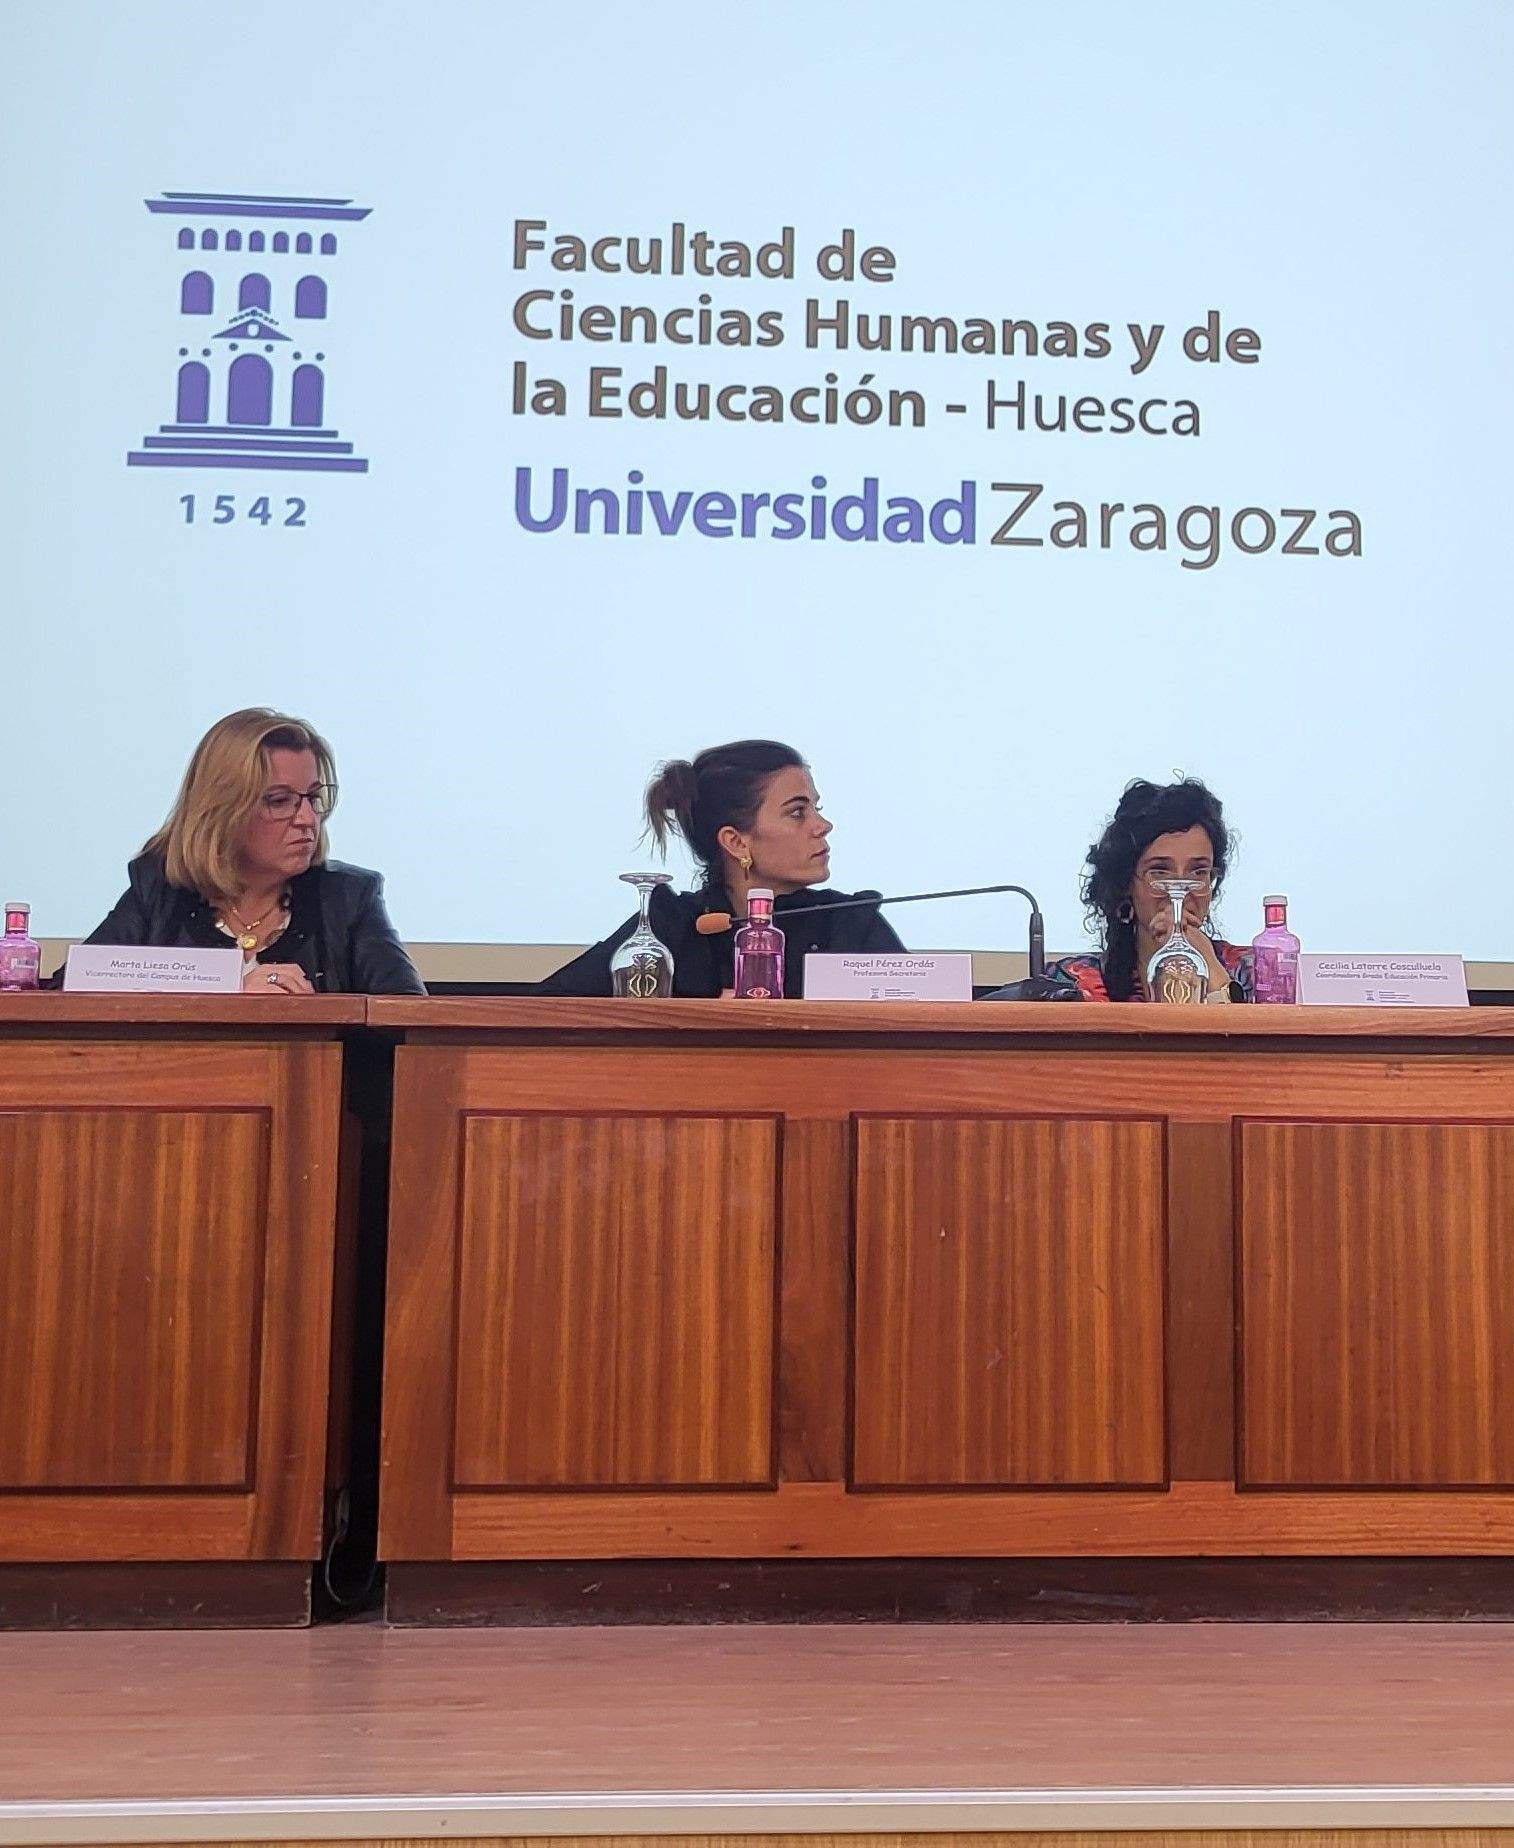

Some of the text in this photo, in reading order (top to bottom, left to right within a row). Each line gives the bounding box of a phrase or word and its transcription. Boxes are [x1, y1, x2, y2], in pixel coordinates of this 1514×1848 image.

[512, 219, 897, 283] Facultad de
[512, 289, 1262, 375] Ciencias Humanas y de
[512, 361, 567, 415] la
[588, 365, 927, 427] Educación
[986, 380, 1202, 436] Huesca
[179, 493, 307, 528] 1542
[514, 466, 1363, 570] Universidad Zaragoza
[110, 959, 141, 969] Marta
[842, 959, 874, 970] Raquel
[876, 958, 903, 969] Pérez
[1318, 962, 1350, 970] Cecilia
[1351, 962, 1388, 970] Latorre
